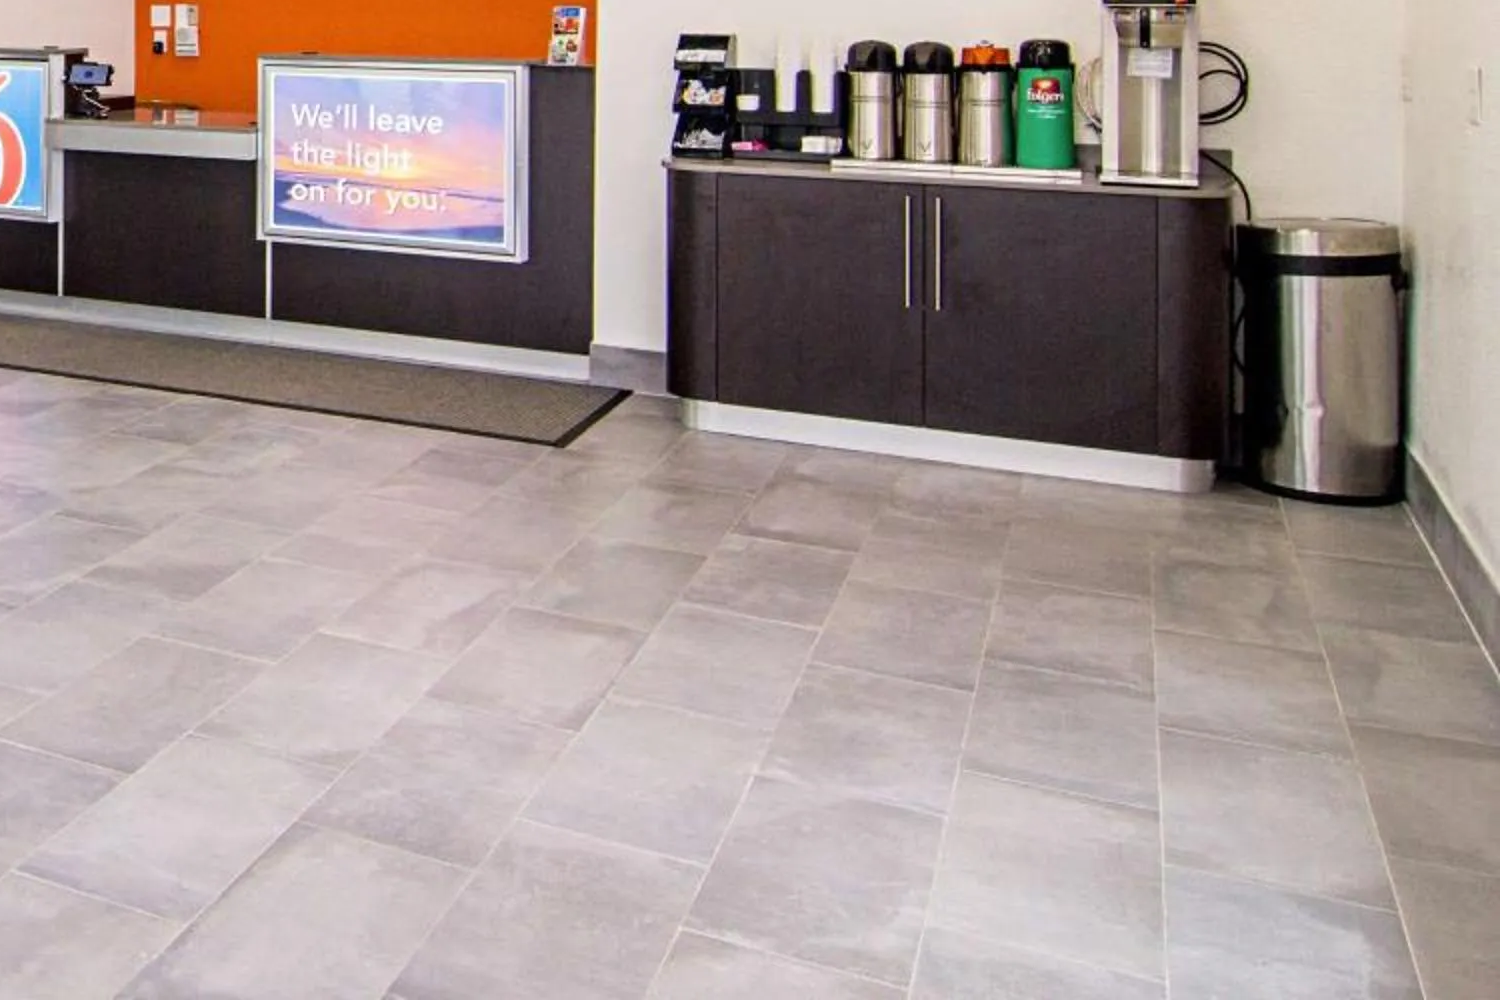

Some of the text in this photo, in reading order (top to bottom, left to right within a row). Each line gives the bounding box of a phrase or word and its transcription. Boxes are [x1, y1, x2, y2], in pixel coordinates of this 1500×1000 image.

[291, 103, 444, 134] We'll leave
[292, 138, 414, 176] the light
[291, 182, 325, 201] on
[335, 178, 376, 205] for
